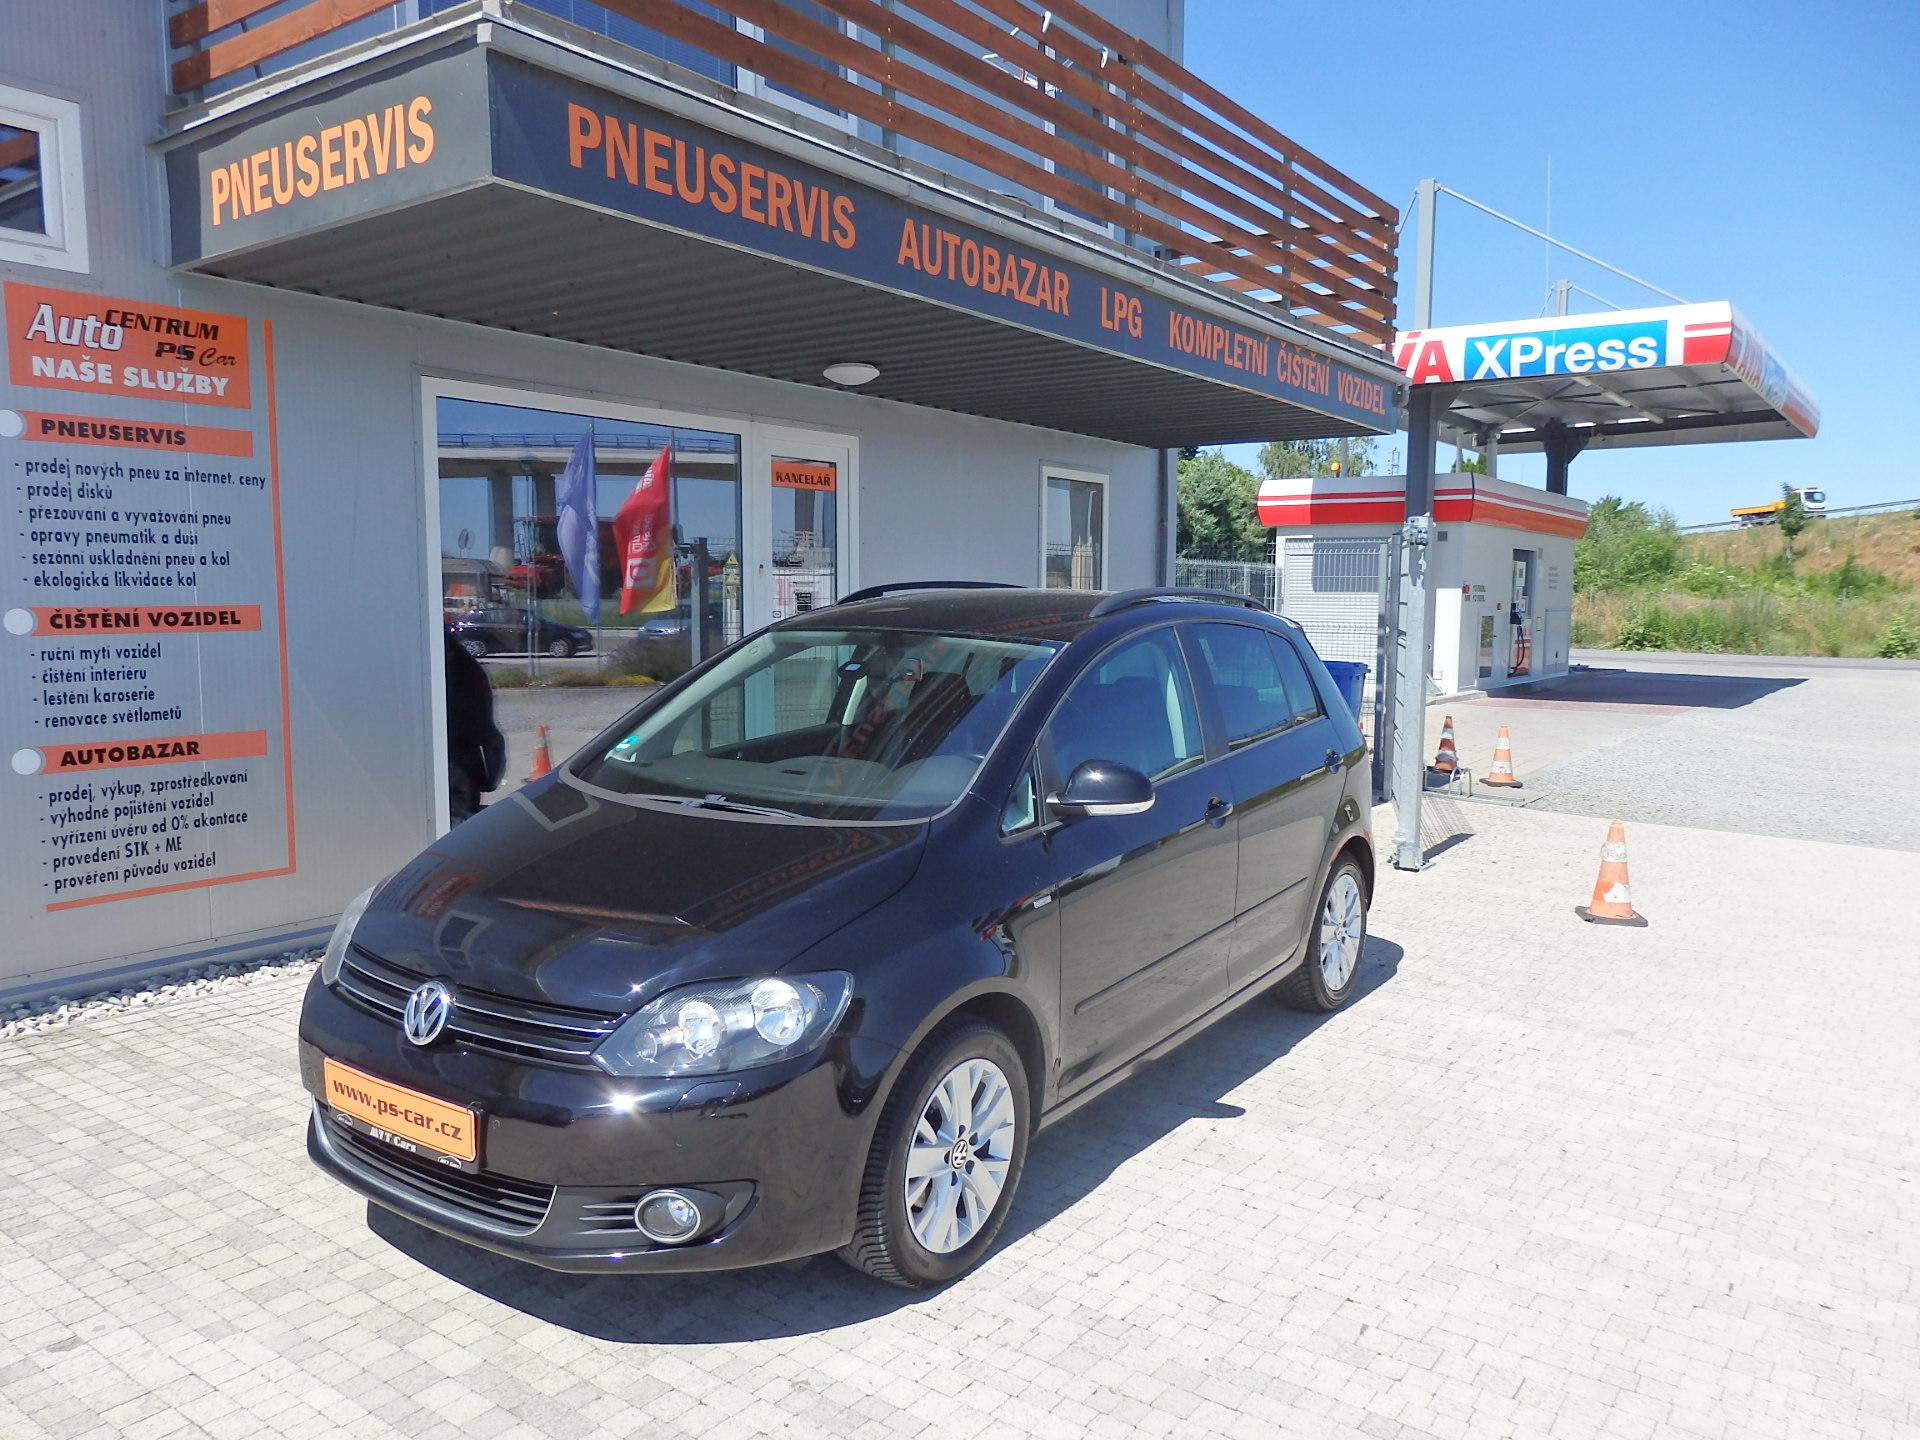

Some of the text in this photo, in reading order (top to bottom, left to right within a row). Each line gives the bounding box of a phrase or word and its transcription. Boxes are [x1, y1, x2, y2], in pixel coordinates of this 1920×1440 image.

[211, 96, 435, 226] PNEUSERVIS
[568, 102, 1385, 416] PNEUSERVIS AUTOBAZAR LPG KOMPLETNÍ ČIŠTĚNÍ VOZIDEL
[25, 303, 124, 351] Auto
[105, 309, 219, 341] CENTRUM
[155, 342, 237, 367] PS Car
[1472, 335, 1658, 380] XPress
[32, 354, 229, 396] NAŠE SLUŽBY
[41, 419, 187, 446] PNEUSERVIS
[26, 458, 70, 478] prodej
[129, 467, 160, 482] pneu
[165, 470, 179, 480] za
[184, 466, 235, 485] internet.
[239, 475, 266, 489] ceny
[776, 471, 831, 487] KANCELÁŘ
[27, 481, 72, 502] prodej
[111, 511, 119, 521] a
[202, 514, 231, 528] pneu
[31, 531, 80, 547] opravy
[86, 528, 156, 547] pneumatik
[161, 534, 169, 544] a
[165, 555, 195, 569] pneu
[199, 555, 207, 565] a
[211, 550, 230, 566] kol
[114, 570, 173, 587] likvidace
[177, 571, 196, 587] kol
[50, 608, 241, 630] ČIŠTĚNÍ VOZIDEL
[116, 642, 161, 659] vozidel
[94, 685, 155, 703] karoserie
[45, 712, 107, 728] renovace
[60, 741, 201, 767] AUTOBAZAR
[171, 791, 214, 809] vozidel
[152, 817, 167, 833] od
[172, 814, 189, 830] 0%
[193, 812, 248, 828] akontace
[125, 840, 149, 858] STK
[165, 836, 182, 852] ME
[173, 851, 216, 871] vozidel
[333, 1079, 463, 1141] www.ps-car.cz
